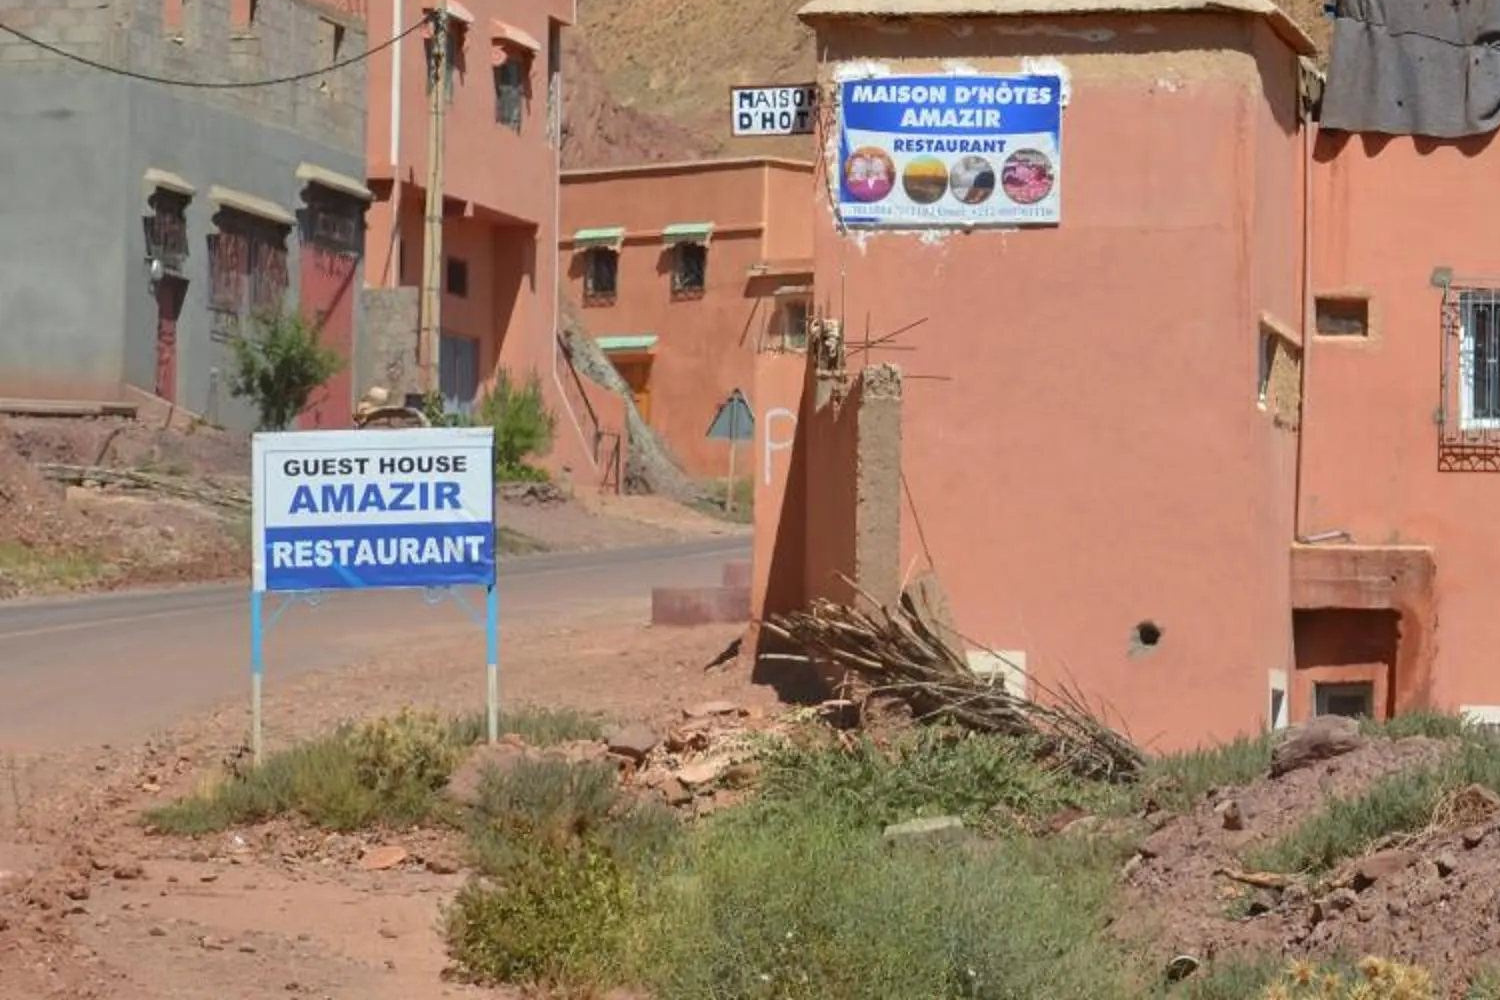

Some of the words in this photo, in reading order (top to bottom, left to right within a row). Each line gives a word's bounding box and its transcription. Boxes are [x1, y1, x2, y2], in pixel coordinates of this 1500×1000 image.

[852, 85, 946, 103] MAISON
[738, 111, 809, 130] D'HOT
[900, 108, 1001, 128] AMAZIR
[893, 138, 1006, 153] RESTAURANT
[283, 457, 369, 477] GUEST
[379, 455, 467, 474] HOUSE
[288, 481, 463, 514] AMAZIR
[272, 535, 486, 569] RESTAURANT
